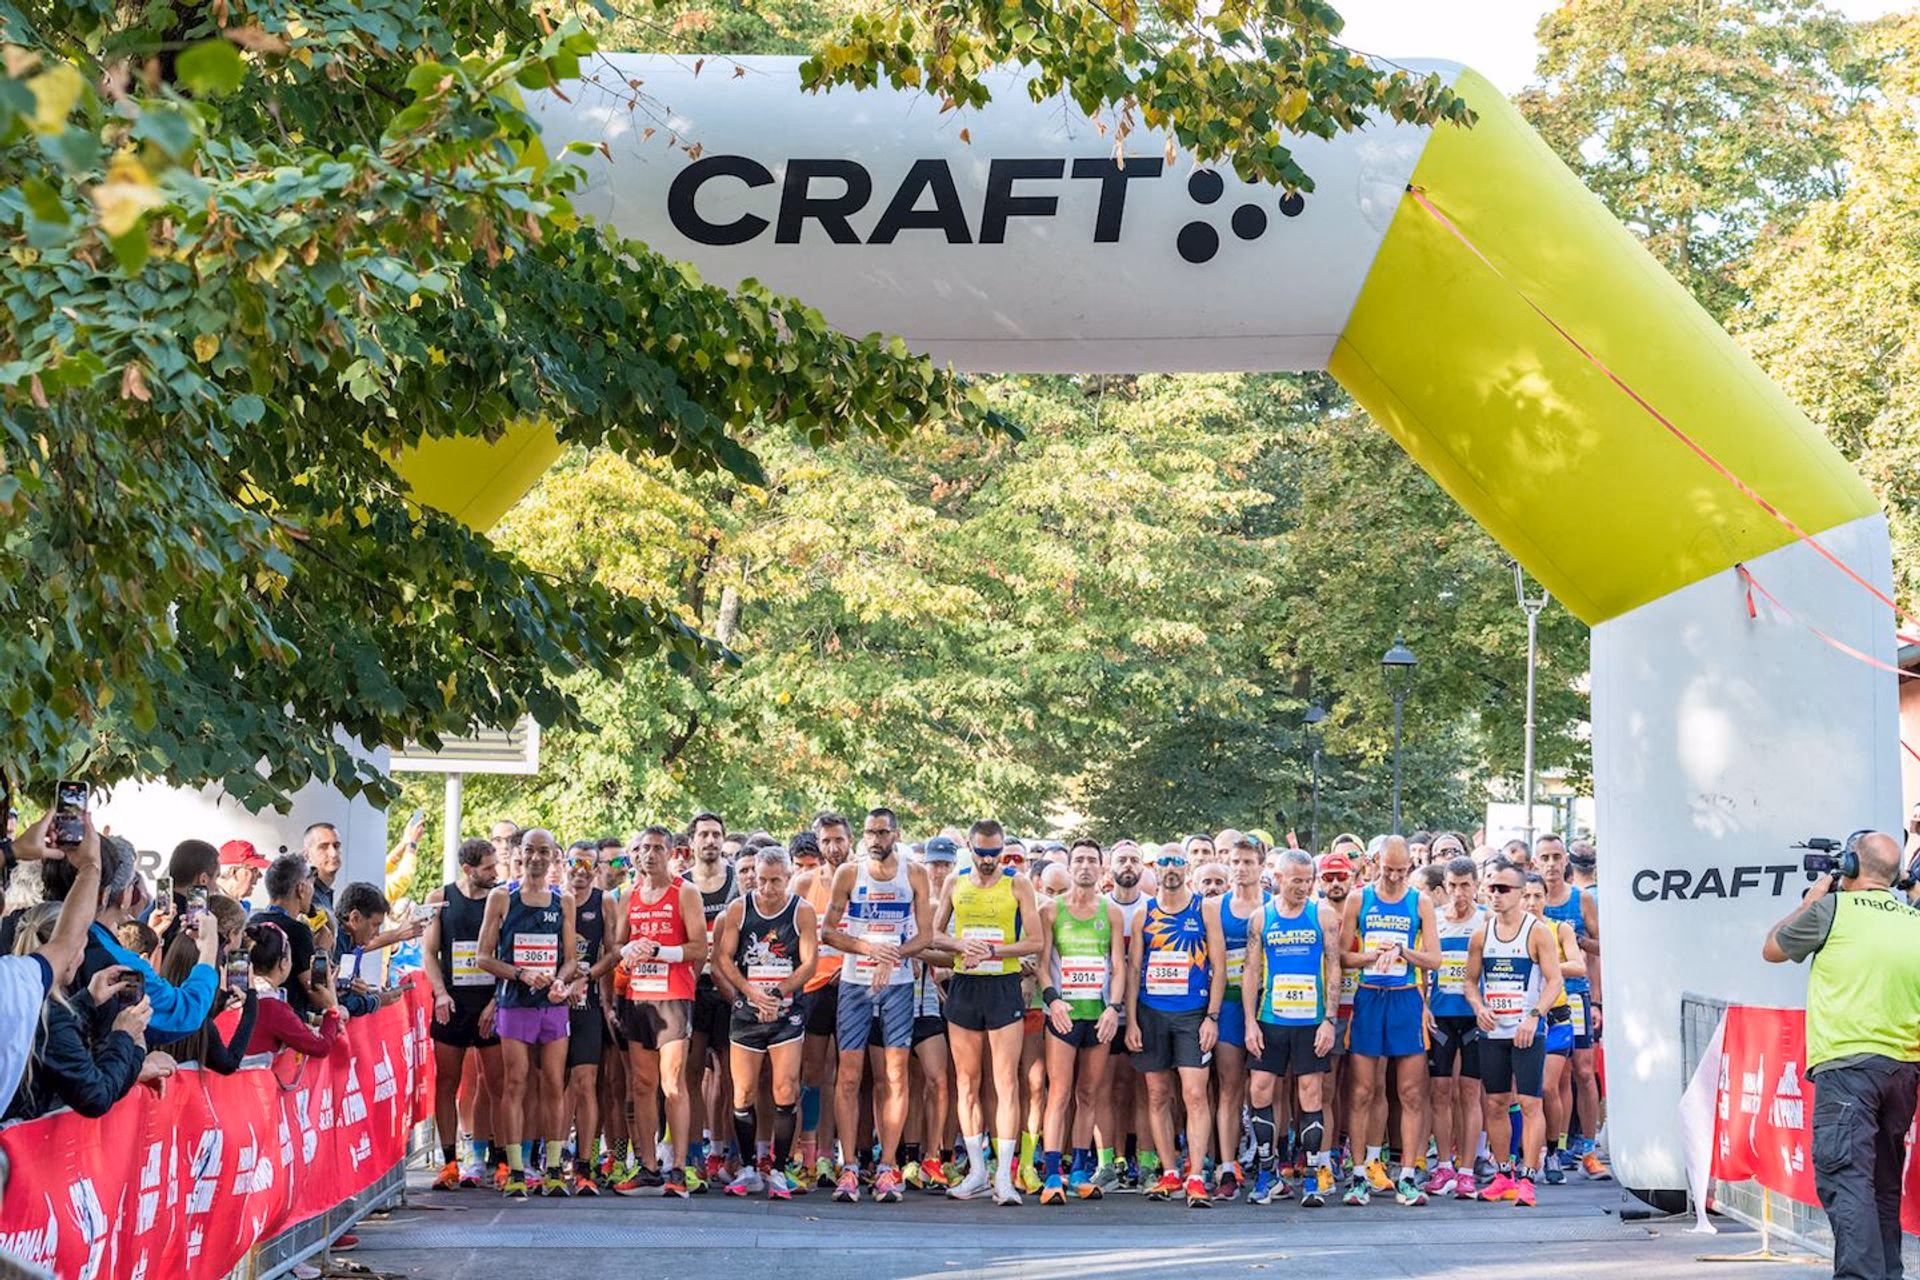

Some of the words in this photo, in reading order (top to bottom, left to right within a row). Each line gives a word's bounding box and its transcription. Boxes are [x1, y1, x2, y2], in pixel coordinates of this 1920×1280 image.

[667, 155, 1164, 246] CRAFT
[1632, 865, 1798, 901] CRAFT
[524, 951, 548, 961] 3061
[1072, 972, 1096, 983] 3014
[1155, 968, 1179, 978] 3364
[1286, 990, 1304, 1001] 481
